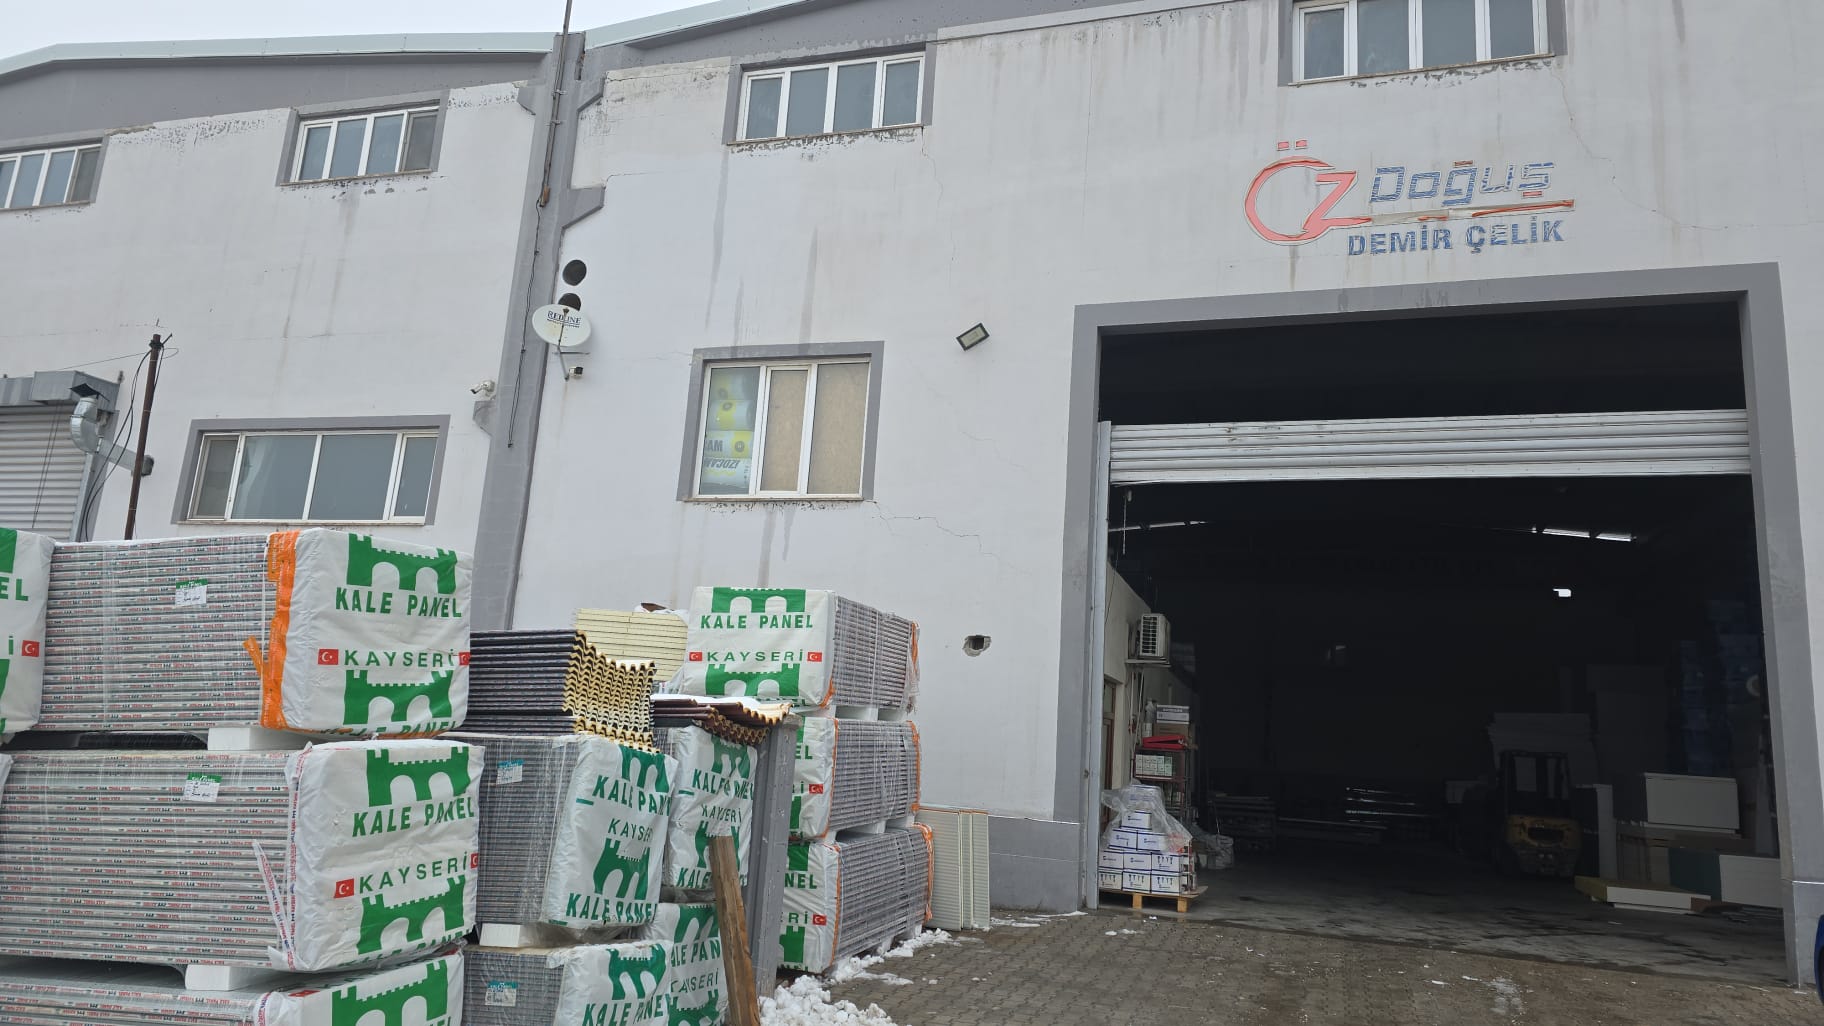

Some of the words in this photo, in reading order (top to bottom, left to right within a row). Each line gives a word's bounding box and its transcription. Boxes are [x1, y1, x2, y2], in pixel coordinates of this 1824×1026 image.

[1348, 224, 1453, 256] DEMİR
[1465, 215, 1565, 254] ÇELİK
[547, 310, 582, 325] REDINE
[336, 587, 393, 614] KALE
[407, 594, 462, 618] PANEL
[701, 614, 747, 629] KALE
[759, 614, 813, 629] PANEL
[344, 648, 455, 667] KAYSERİ
[707, 648, 804, 662] KAYSERİ
[352, 806, 412, 837] KALE
[424, 797, 475, 826] PANEL
[359, 851, 468, 894] KAYSERİ
[784, 872, 818, 890] NEL
[566, 892, 610, 922] KALE
[671, 944, 688, 967] ALE
[690, 940, 720, 963] PAN
[582, 1002, 632, 1026] KALE
